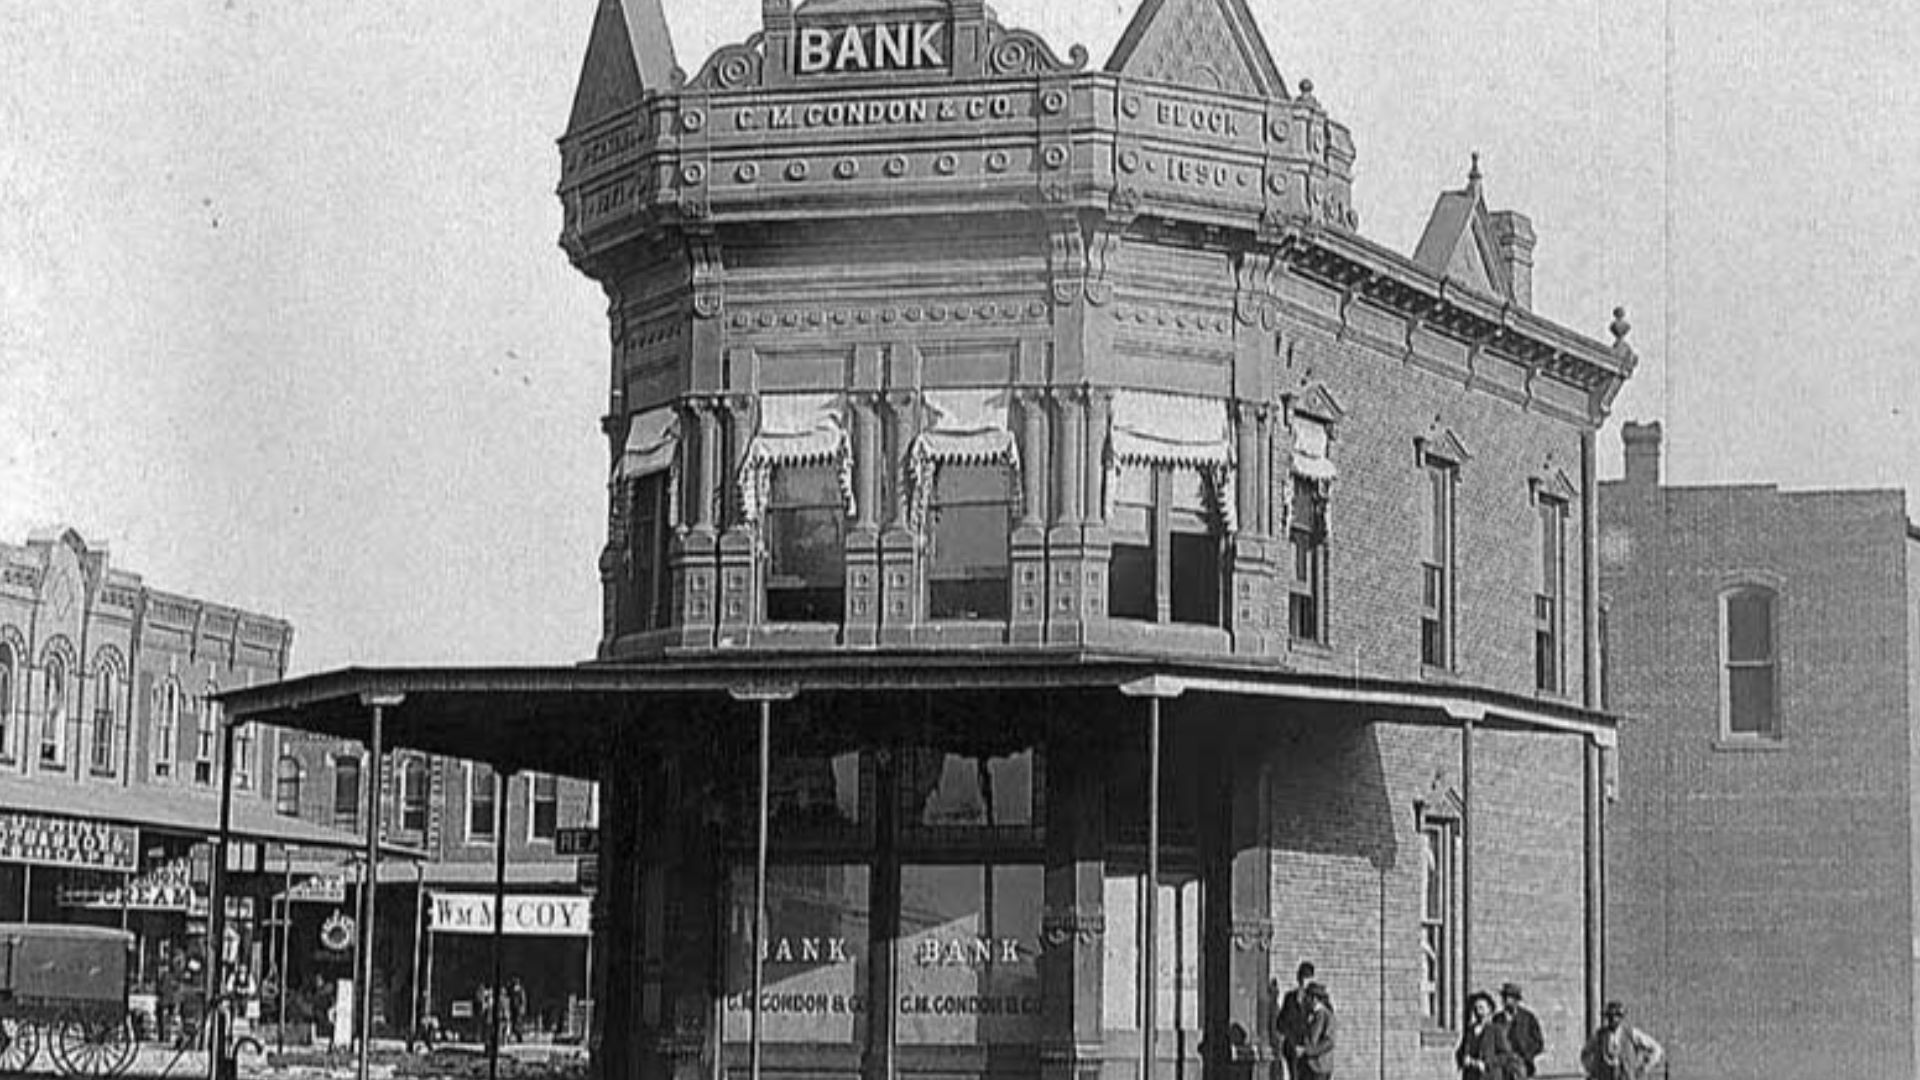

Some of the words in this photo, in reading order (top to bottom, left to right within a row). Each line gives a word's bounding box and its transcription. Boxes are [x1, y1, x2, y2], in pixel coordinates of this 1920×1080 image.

[800, 22, 946, 72] BANK
[804, 99, 928, 127] CONDON
[938, 97, 957, 120] &
[1156, 99, 1240, 137] BLOCK
[481, 900, 580, 928] MCOY
[919, 937, 1019, 964] BANK
